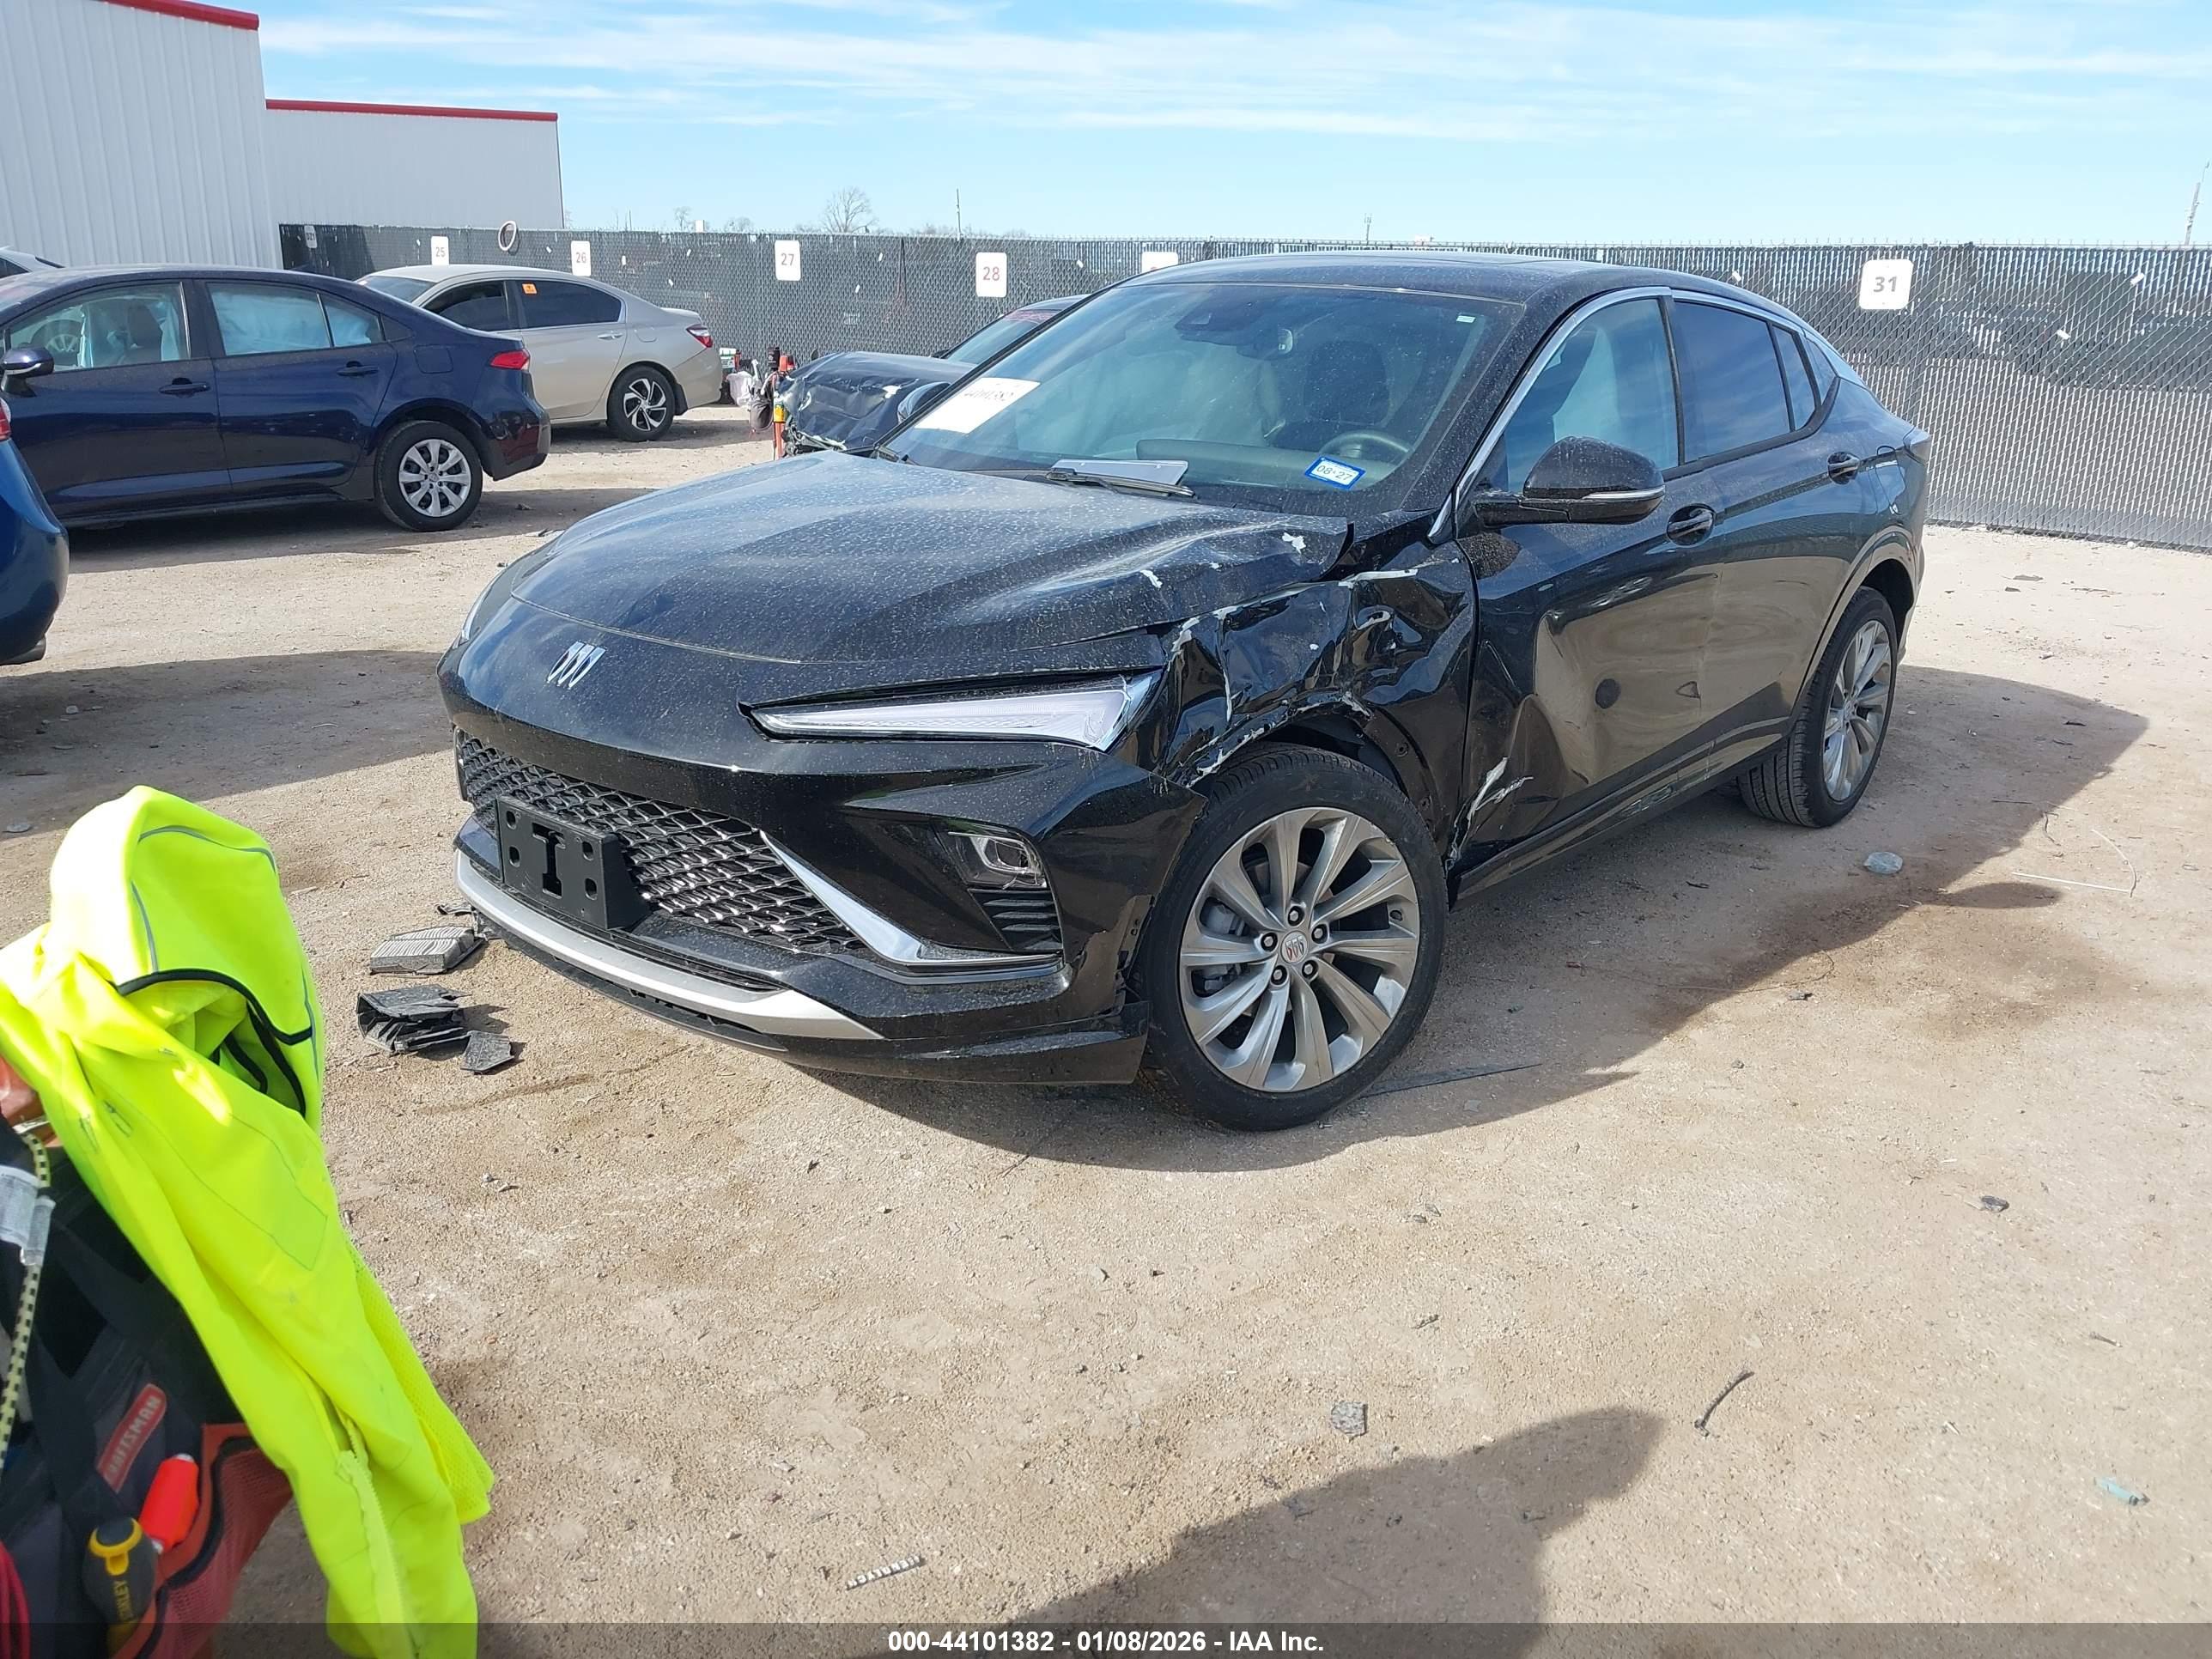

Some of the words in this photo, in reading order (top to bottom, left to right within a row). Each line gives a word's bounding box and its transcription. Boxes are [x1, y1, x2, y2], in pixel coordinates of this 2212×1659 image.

[435, 246, 446, 258] 25
[575, 252, 586, 264] 26
[781, 252, 795, 266] 27
[982, 266, 1000, 282] 28
[1873, 276, 1897, 293] 31
[1316, 465, 1333, 475] 08
[1335, 471, 1352, 480] 27
